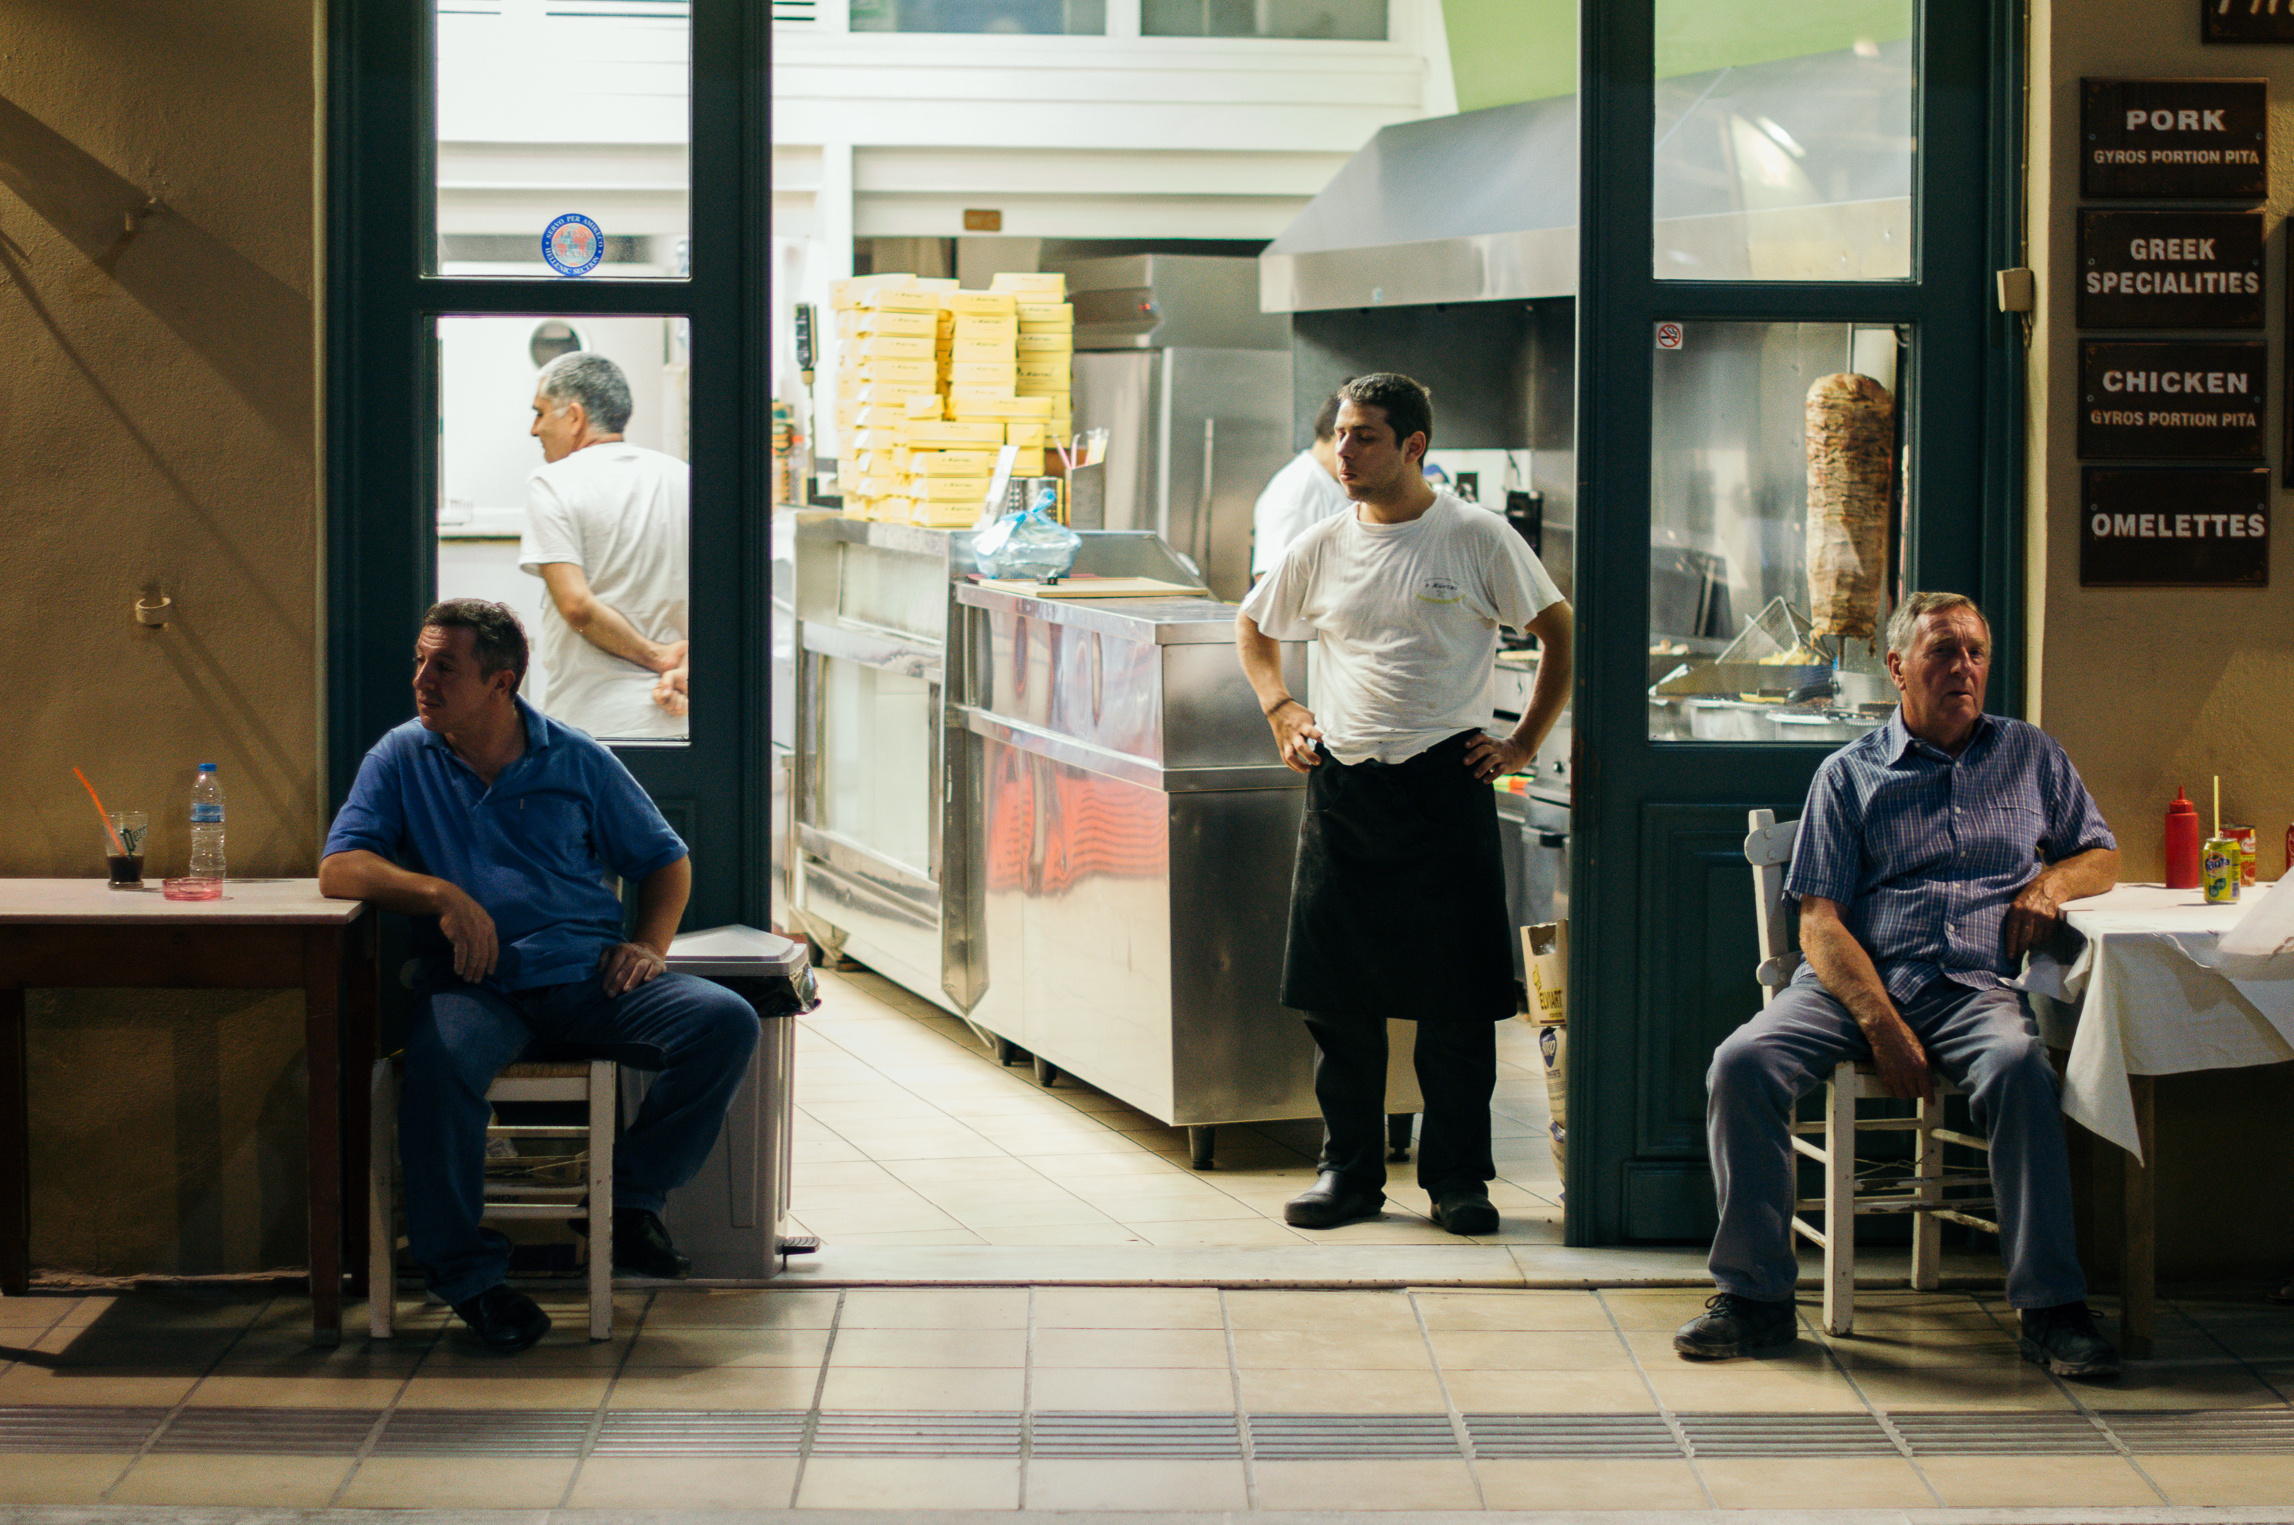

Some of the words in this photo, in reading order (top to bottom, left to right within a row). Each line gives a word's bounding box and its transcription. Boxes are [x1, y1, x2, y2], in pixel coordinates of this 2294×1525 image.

[2126, 109, 2227, 131] PORK
[2094, 150, 2147, 164] GYROS
[2151, 150, 2221, 164] PORTION
[2225, 150, 2260, 164] PITA
[2130, 238, 2216, 261] GREEK
[2086, 271, 2260, 294] SPECIALITIES
[2102, 369, 2248, 394] CHICKEN
[2091, 409, 2144, 426] GYROS
[2148, 411, 2218, 427] PORTION
[2221, 412, 2256, 427] PITA
[2091, 512, 2266, 538] OMELETTES
